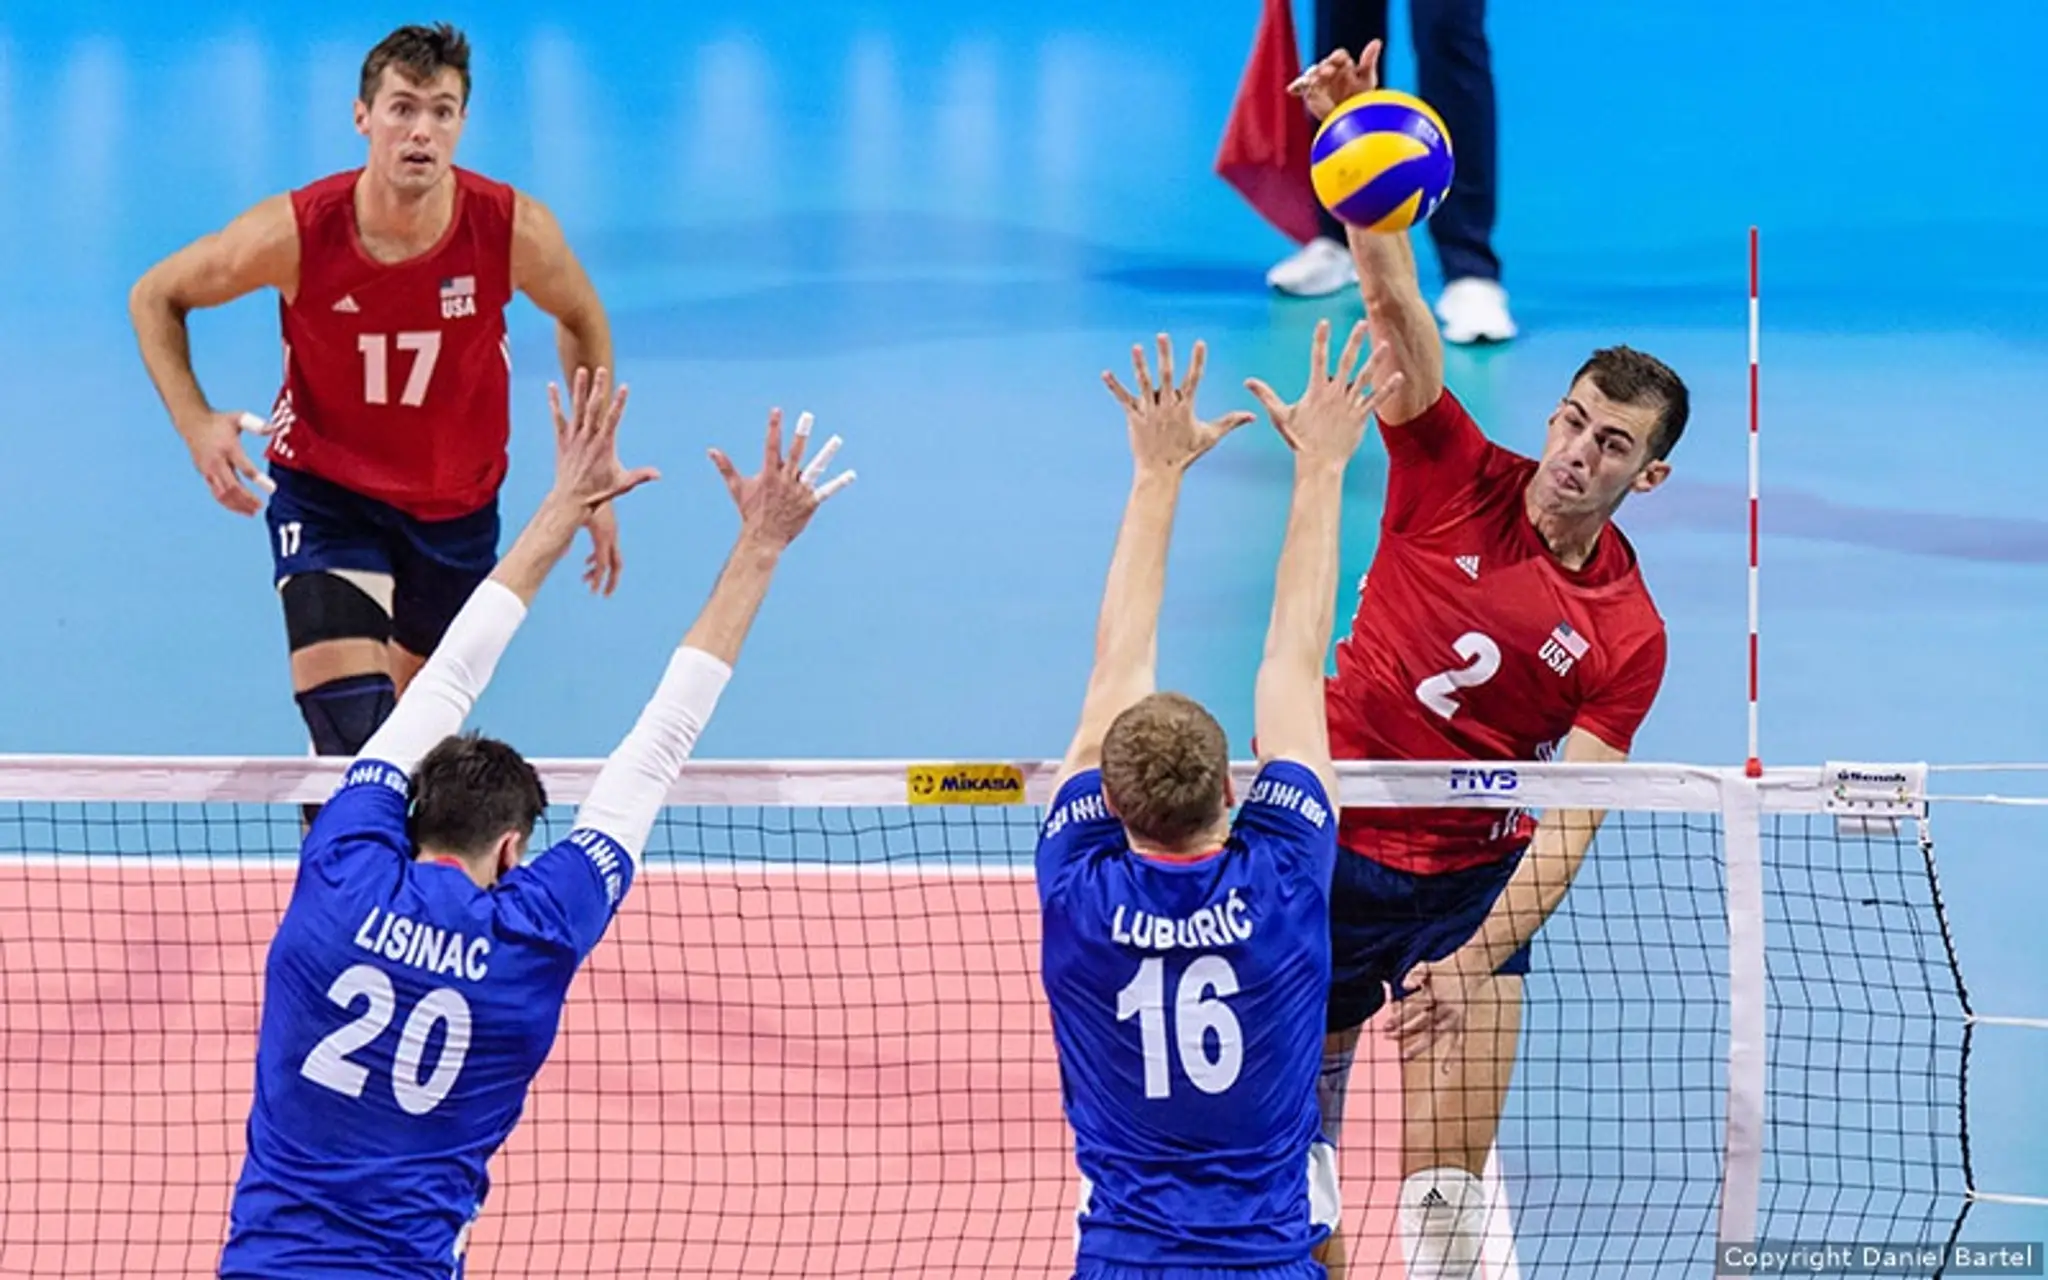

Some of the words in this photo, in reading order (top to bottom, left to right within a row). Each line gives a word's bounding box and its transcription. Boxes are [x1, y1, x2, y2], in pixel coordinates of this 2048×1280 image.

[440, 296, 477, 319] USA
[357, 331, 442, 407] 17
[278, 522, 303, 558] 17
[1414, 631, 1502, 721] 2
[1537, 637, 1575, 677] USA
[354, 905, 491, 982] LISINAC
[1111, 887, 1253, 949] LUBURIĆ
[300, 964, 473, 1116] 20
[1116, 955, 1244, 1100] 16
